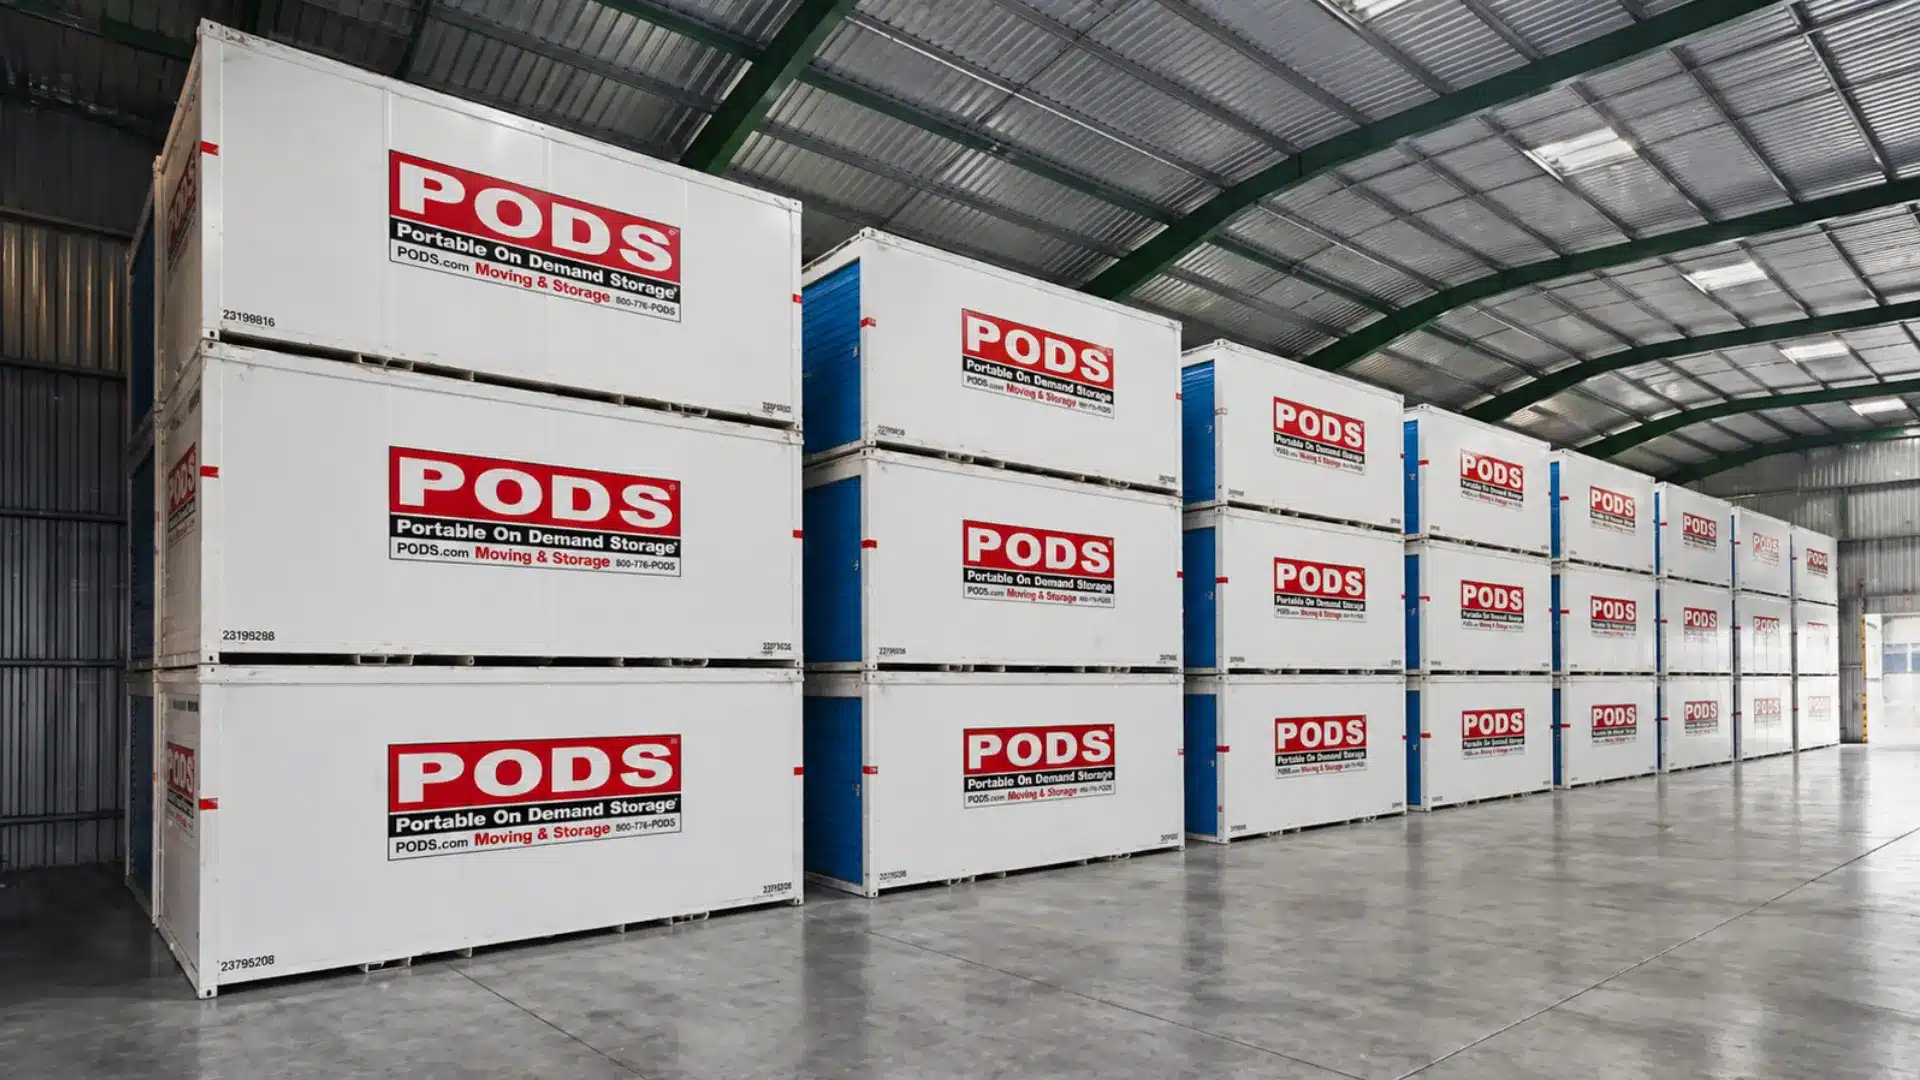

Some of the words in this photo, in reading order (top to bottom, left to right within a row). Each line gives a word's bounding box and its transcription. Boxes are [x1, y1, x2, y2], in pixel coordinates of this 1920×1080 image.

[399, 161, 672, 272] PODS
[397, 223, 487, 257] Portable
[494, 246, 521, 265] On
[528, 254, 603, 283] Demand
[610, 274, 676, 299] Storage
[398, 247, 469, 272] PODS.com
[475, 262, 532, 288] Moving
[537, 276, 548, 289] &
[553, 280, 610, 303] Storage
[966, 315, 1109, 382] PODS
[967, 359, 1013, 379] Portable
[1016, 370, 1031, 383] On
[1034, 376, 1074, 393] Demand
[1077, 386, 1112, 403] Storage
[1276, 402, 1362, 447] PODS
[169, 449, 196, 508] PODS
[1462, 454, 1521, 488] PODS
[399, 456, 673, 528] PODS
[1591, 489, 1634, 516] PODS
[397, 518, 486, 540] Portable
[494, 527, 521, 542] On
[528, 530, 603, 548] Demand
[610, 537, 676, 555] Storage
[1684, 515, 1715, 537] PODS
[398, 542, 469, 558] PODS.com
[475, 546, 532, 565] Moving
[537, 551, 548, 563] &
[553, 551, 610, 569] Storage
[616, 558, 675, 571] 800-776-PODS
[968, 526, 1110, 573] PODS
[967, 570, 1013, 584] Portable
[1016, 574, 1031, 585] On
[1034, 576, 1074, 589] Demand
[1077, 580, 1112, 593] Storage
[1276, 562, 1363, 596] PODS
[1462, 584, 1522, 610] PODS
[1592, 599, 1635, 620] PODS
[1684, 610, 1716, 628] PODS
[1463, 712, 1523, 736] PODS
[1593, 707, 1635, 726] PODS
[1685, 703, 1717, 720] PODS
[968, 730, 1111, 769] PODS
[1277, 719, 1364, 749] PODS
[398, 743, 673, 803] PODS
[968, 778, 1013, 789] Portable
[1018, 775, 1032, 786] On
[1035, 771, 1075, 783] Demand
[1078, 770, 1113, 780] Storage
[1047, 787, 1078, 798] Storage
[396, 813, 486, 832] Portable
[494, 810, 521, 825] On
[528, 804, 603, 821] Demand
[610, 799, 676, 814] Storage
[396, 838, 468, 854] PODS.com
[474, 830, 532, 847] Moving
[537, 828, 548, 840] &
[554, 823, 610, 839] Storage
[616, 818, 676, 832] 800-776-PODS
[221, 954, 275, 972] 23795208
